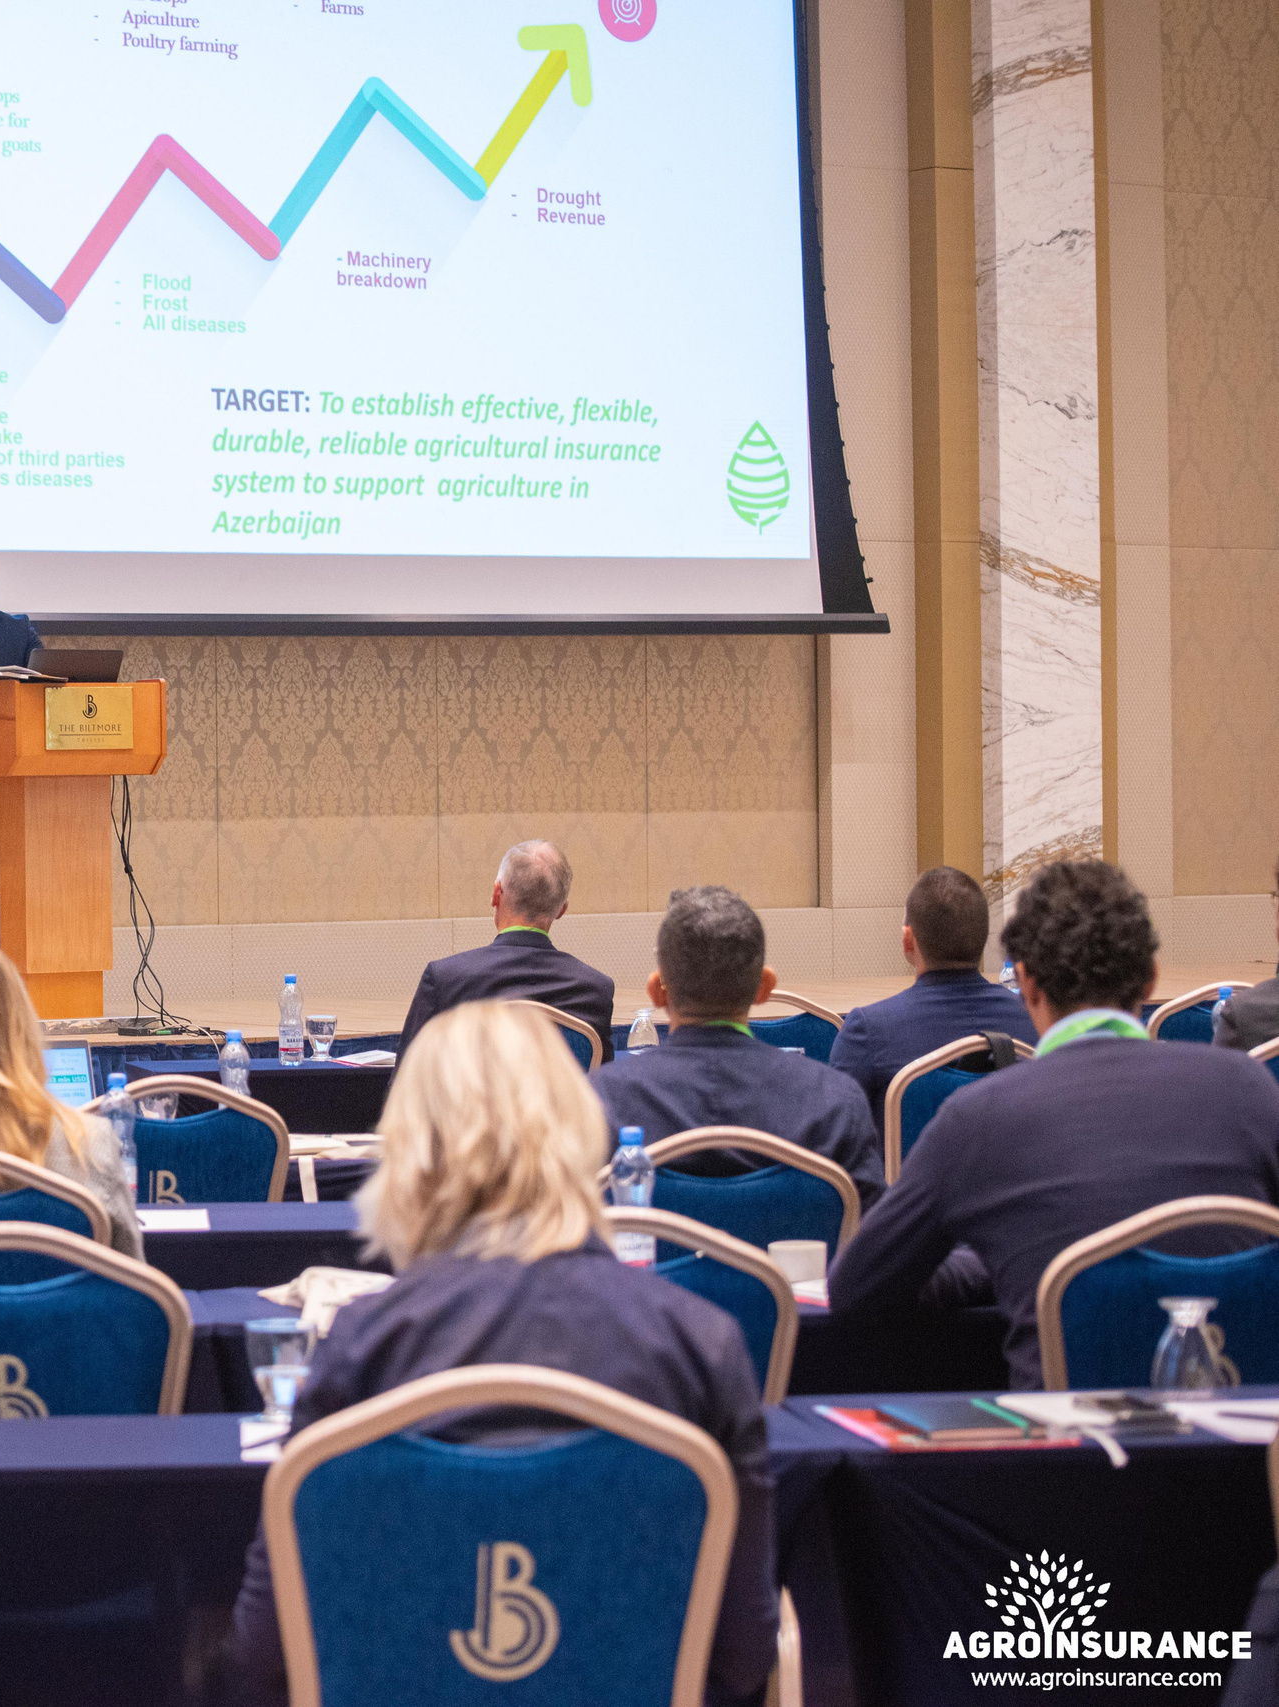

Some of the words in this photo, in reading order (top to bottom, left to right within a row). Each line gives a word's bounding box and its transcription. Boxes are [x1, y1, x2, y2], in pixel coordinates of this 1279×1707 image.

[321, 0, 364, 15] Farms
[123, 10, 199, 29] Apiculture
[123, 32, 175, 55] Poultry
[180, 36, 238, 60] farming
[8, 112, 30, 128] for
[2, 140, 41, 157] goats
[537, 188, 601, 209] Drought
[538, 208, 605, 225] Revenue
[347, 251, 431, 273] Machinery
[143, 273, 191, 291] Flood
[337, 270, 426, 289] breakdown
[143, 294, 188, 311] Frost
[143, 314, 165, 330] All
[171, 315, 246, 333] diseases
[211, 388, 310, 413] TARGET:
[320, 391, 344, 414] To
[352, 392, 454, 417] establish
[462, 393, 564, 425] effective,
[570, 397, 658, 428] flexible,
[212, 427, 310, 458] durable,
[319, 431, 407, 456] reliable
[415, 434, 548, 462] agricultural
[555, 437, 661, 462] insurance
[19, 450, 59, 466] third
[66, 451, 125, 471] parties
[16, 470, 93, 487] diseases
[212, 471, 295, 498] system
[303, 472, 327, 494] to
[333, 474, 425, 501] support
[438, 474, 562, 502] agriculture
[569, 481, 589, 498] in
[212, 509, 341, 540] Azerbaijan
[58, 724, 75, 733] THE
[79, 724, 122, 733] BILTMORE
